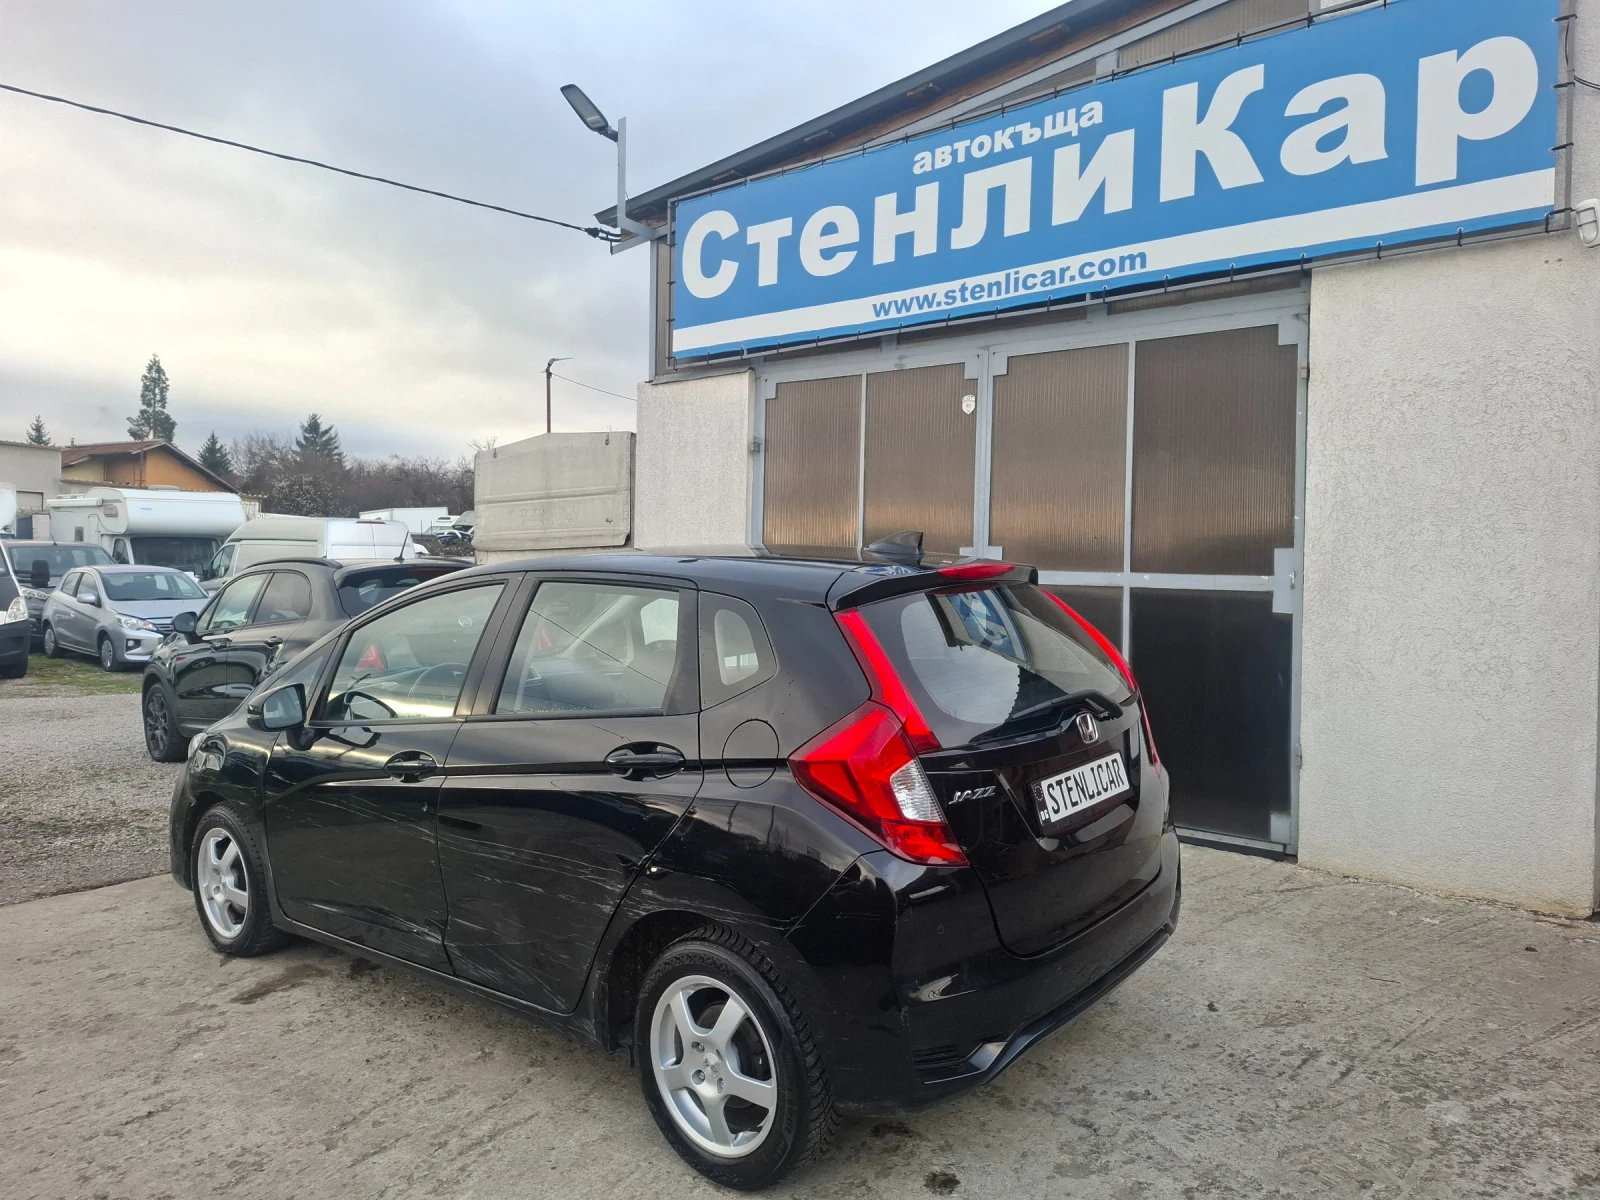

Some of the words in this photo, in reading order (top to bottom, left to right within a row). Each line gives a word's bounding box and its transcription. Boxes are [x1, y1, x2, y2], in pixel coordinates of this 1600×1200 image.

[681, 36, 1539, 299] СтенлиКар
[913, 101, 1104, 174] автокъща
[873, 252, 1147, 318] www.stenlicar.com
[948, 785, 996, 805] JAZZ
[1046, 757, 1125, 815] STENLICAR
